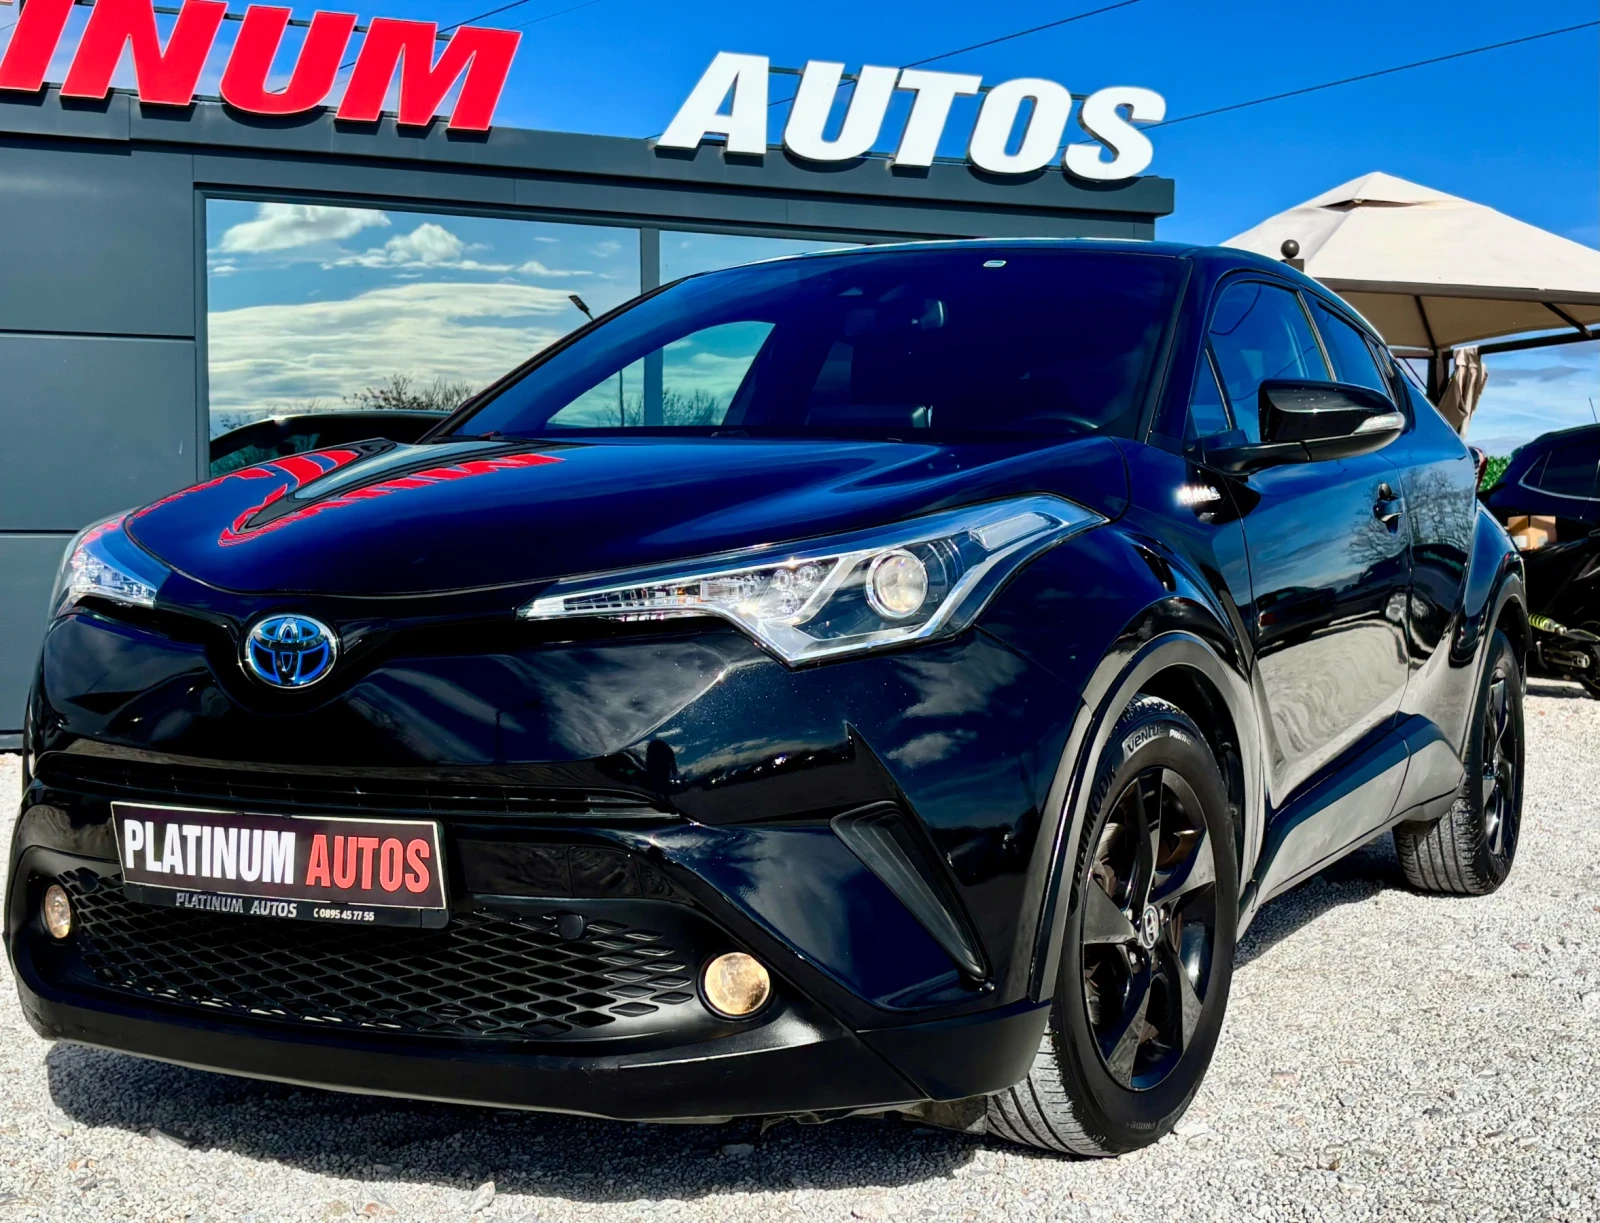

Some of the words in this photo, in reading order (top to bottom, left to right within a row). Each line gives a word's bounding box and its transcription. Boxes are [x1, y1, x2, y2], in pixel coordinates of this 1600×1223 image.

[653, 51, 1167, 181] AUTOS
[123, 819, 296, 884] PLATINUM
[306, 834, 430, 893] AUTOS
[176, 892, 244, 913] PLATINUM
[250, 900, 297, 918] AUTOS
[320, 909, 341, 920] 0895
[341, 910, 352, 920] 45
[353, 911, 363, 921] 77
[364, 911, 375, 921] 55
